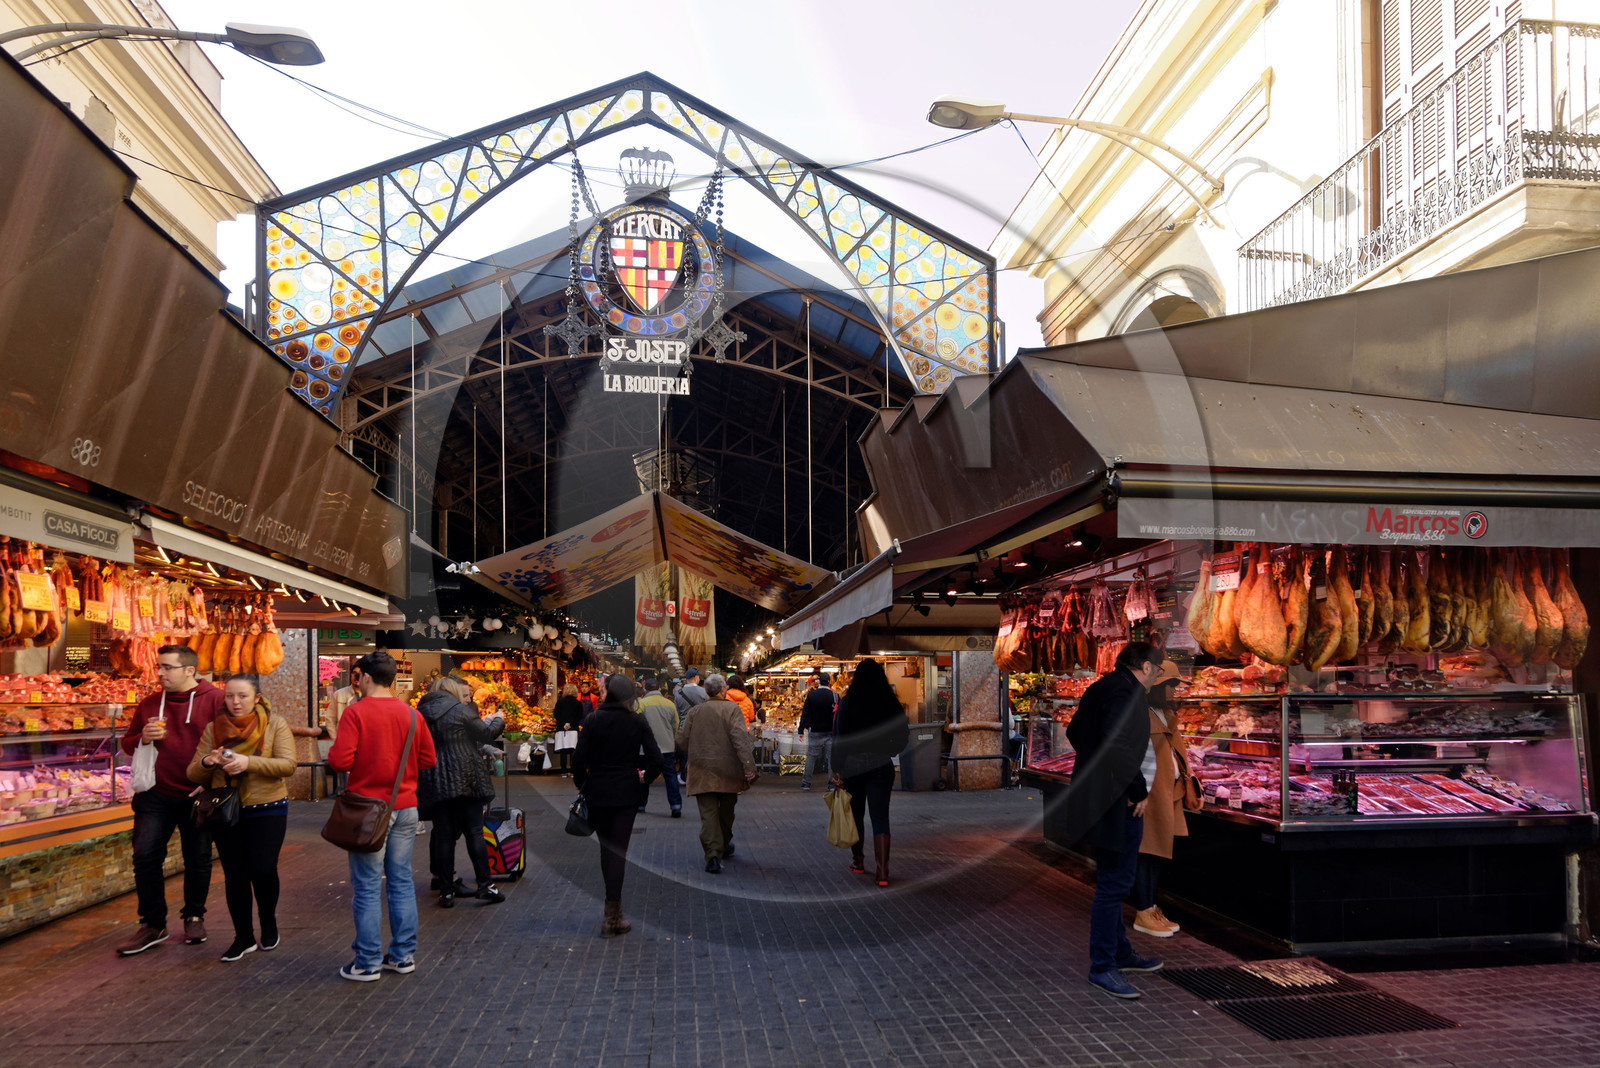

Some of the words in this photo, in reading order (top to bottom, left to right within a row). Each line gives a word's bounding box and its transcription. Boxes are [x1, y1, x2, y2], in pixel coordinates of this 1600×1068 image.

[613, 213, 682, 240] MERCAT
[626, 339, 687, 364] JOSEP
[604, 374, 622, 392] LA
[624, 375, 690, 395] BOQUERIA
[71, 437, 101, 467] 888
[47, 517, 79, 536] CASA
[1366, 507, 1460, 535] Marcos
